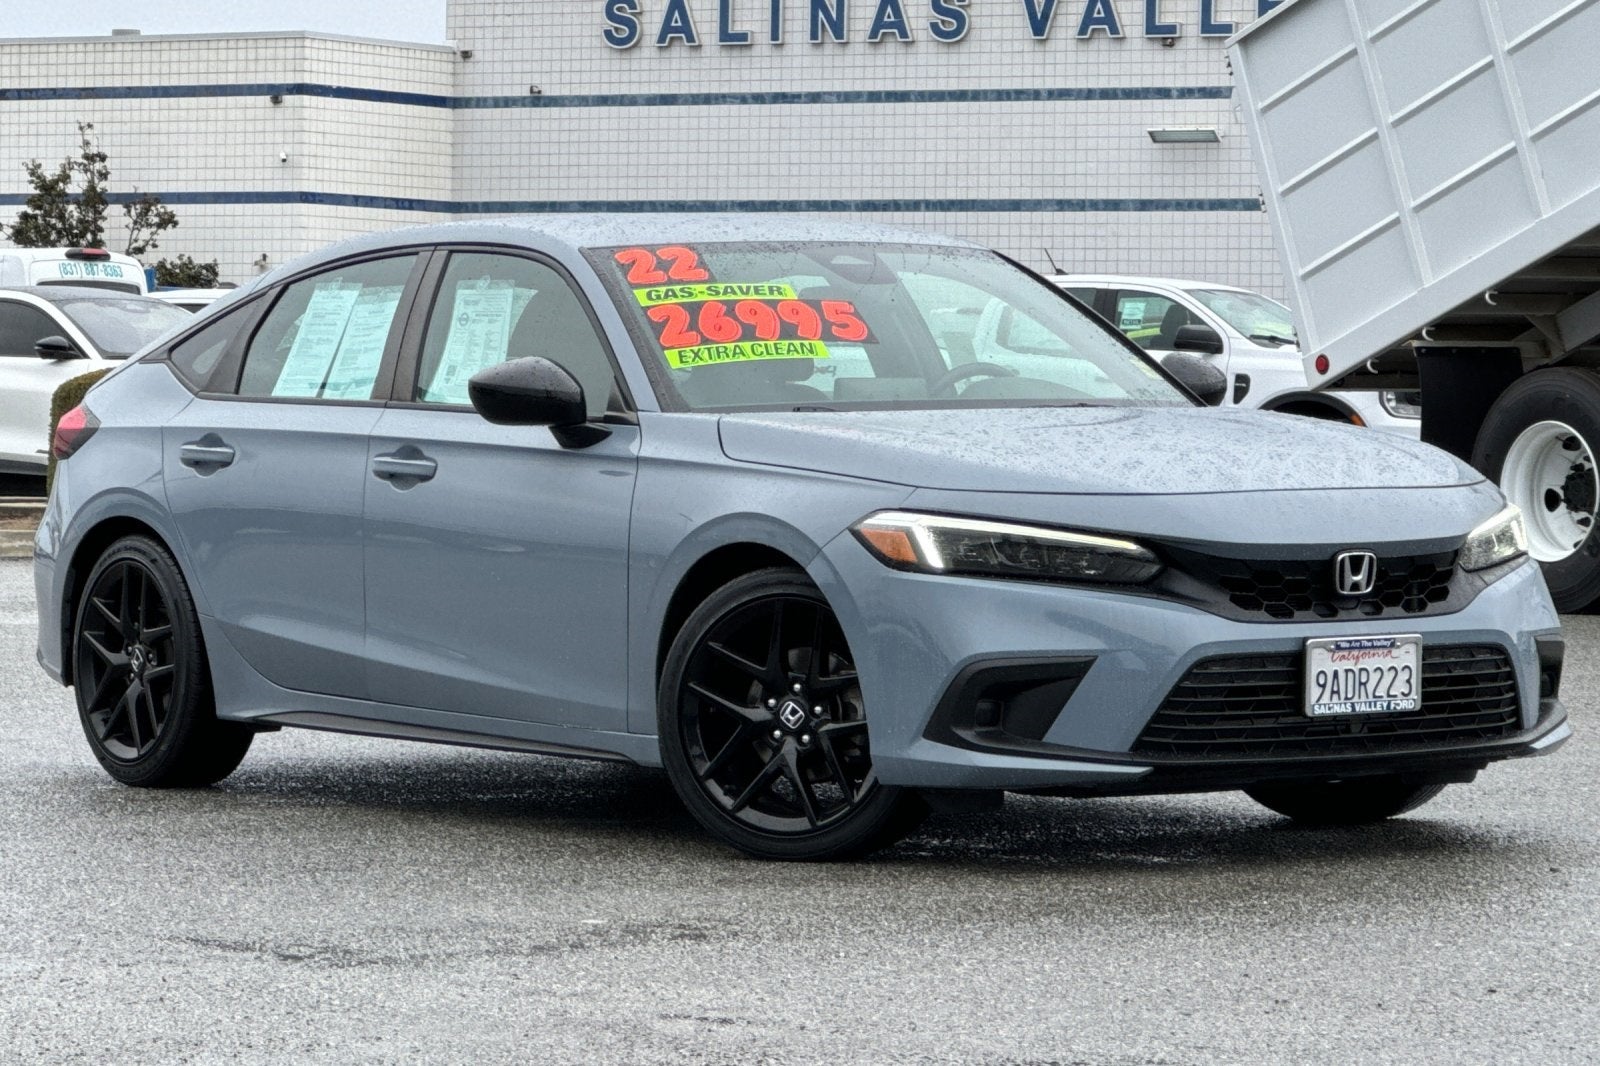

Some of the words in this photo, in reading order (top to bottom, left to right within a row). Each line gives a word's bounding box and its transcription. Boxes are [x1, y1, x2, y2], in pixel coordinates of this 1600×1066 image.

[602, 0, 970, 48] SALINAS
[59, 262, 82, 278] (831)
[614, 247, 709, 284] 22
[646, 285, 786, 301] GAS-SAVER
[648, 300, 868, 347] 26995
[677, 342, 746, 365] EXTRA
[750, 341, 818, 358] CLEAN
[1361, 640, 1373, 648] The
[1331, 649, 1400, 666] California
[1316, 665, 1412, 703] 9ADR223
[1355, 701, 1388, 712] VALLEY
[1390, 700, 1415, 709] FORD
